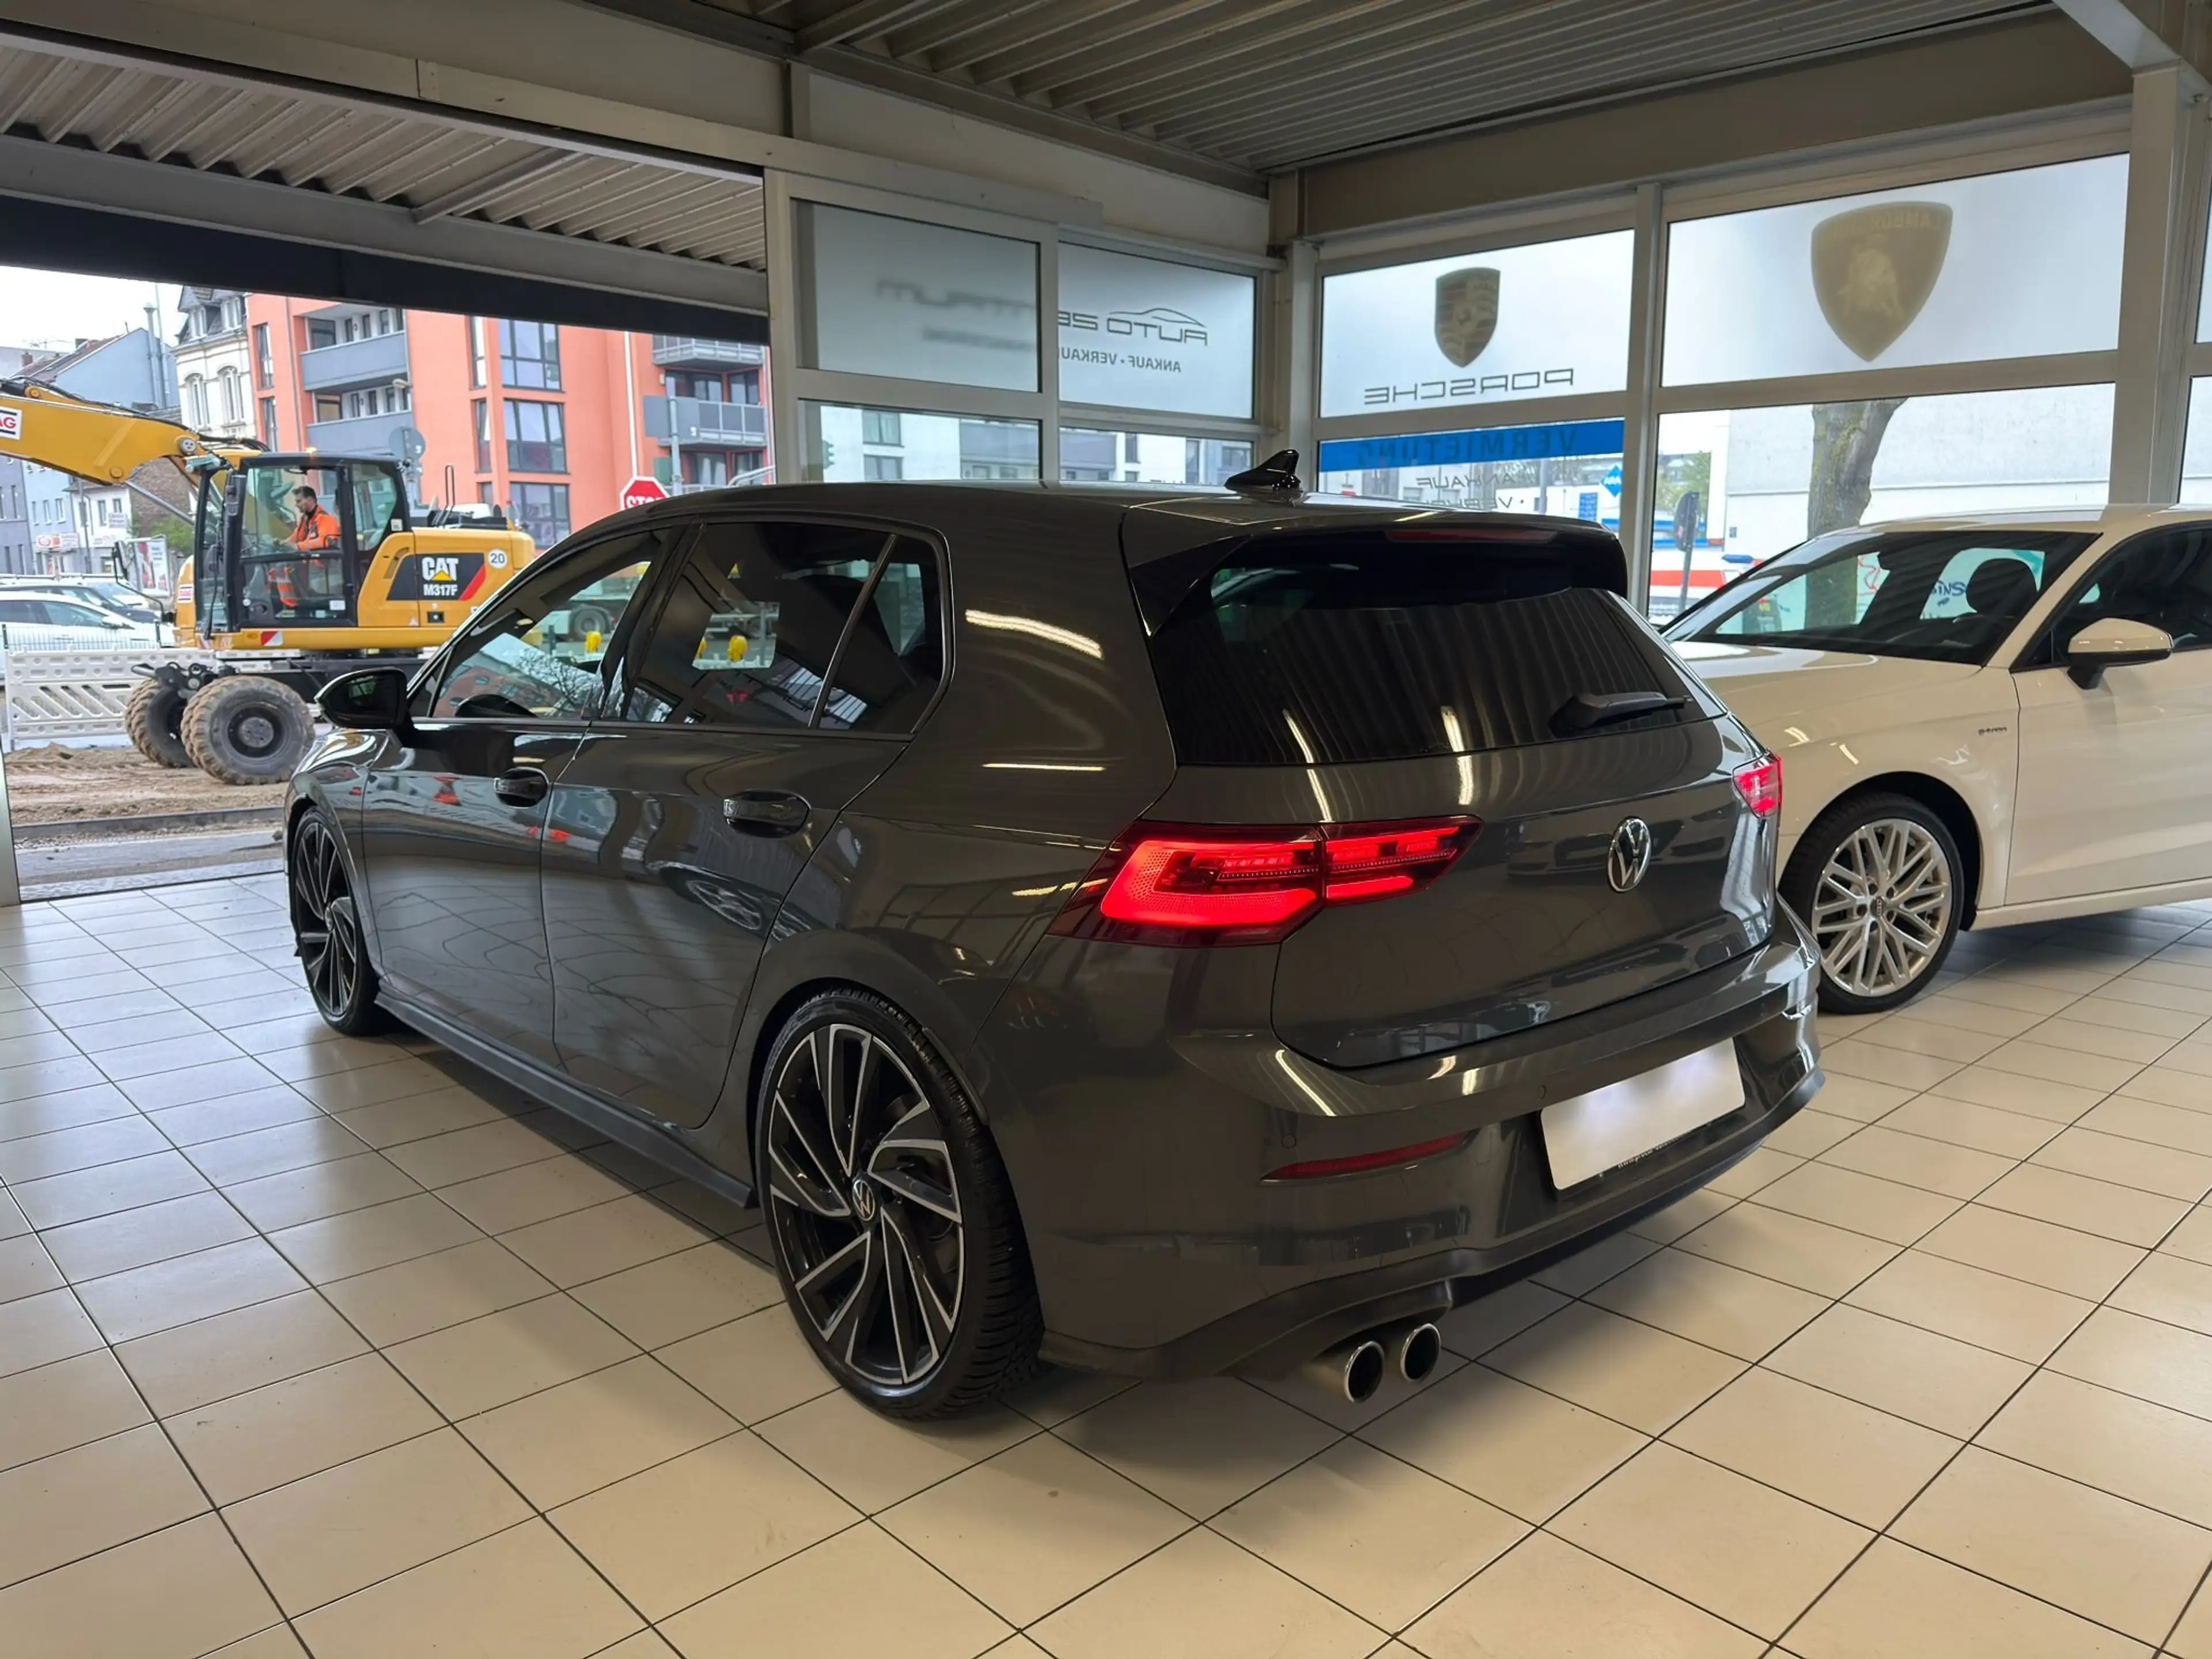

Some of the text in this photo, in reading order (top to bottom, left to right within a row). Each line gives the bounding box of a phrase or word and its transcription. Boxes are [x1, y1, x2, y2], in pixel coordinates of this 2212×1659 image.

[491, 553, 505, 564] 20
[422, 556, 459, 581] CAT
[423, 584, 458, 596] M317F
